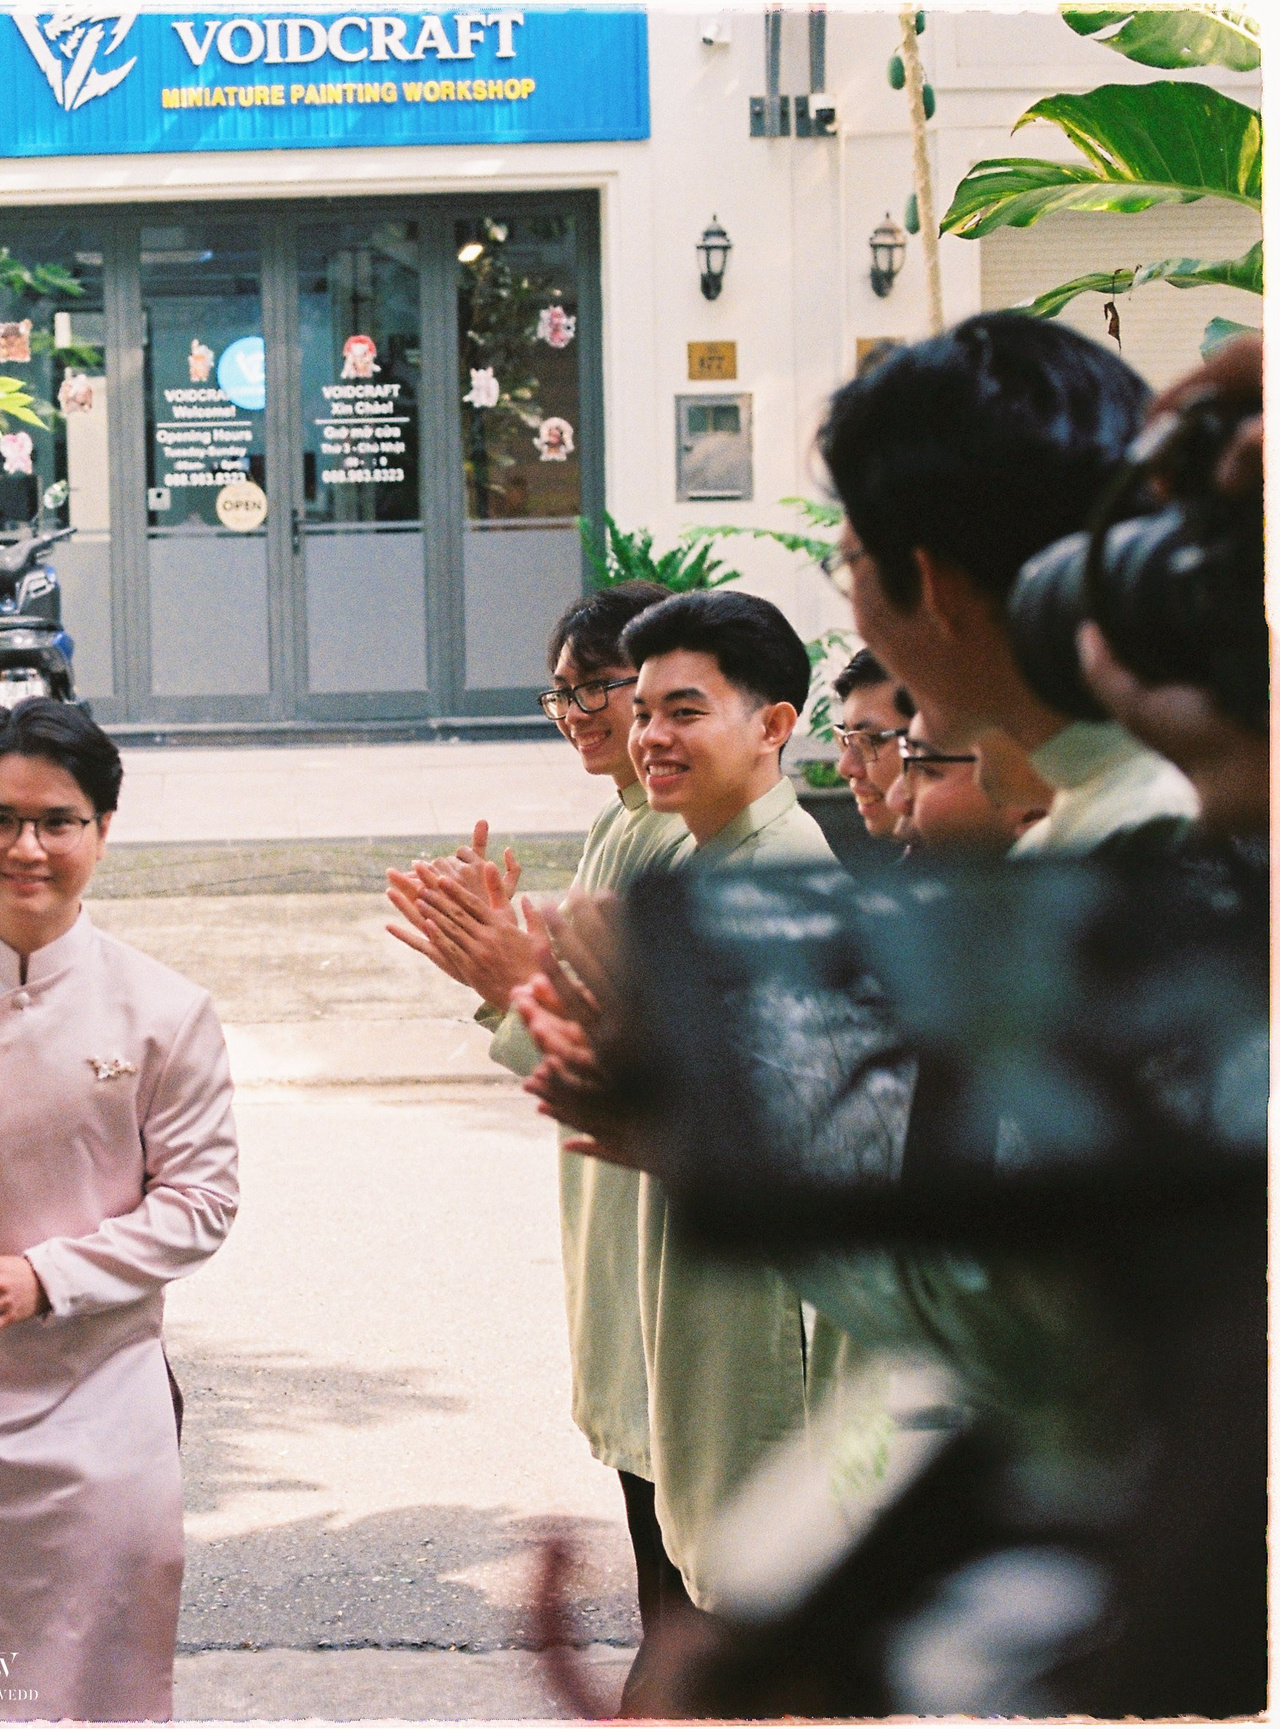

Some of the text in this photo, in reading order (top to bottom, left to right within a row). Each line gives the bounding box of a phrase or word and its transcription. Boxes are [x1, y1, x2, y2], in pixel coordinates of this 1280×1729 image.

[172, 13, 524, 66] VOIDCRAFT
[162, 78, 536, 108] MINIATURE PAINTING WORKSHOP
[164, 389, 234, 402] VOIDCRA
[322, 384, 400, 399] VOIDCRAFT
[172, 405, 236, 418] Welcome!
[331, 402, 353, 415] Xin
[156, 429, 253, 444] Opening Hours
[222, 499, 262, 512] OPEN
